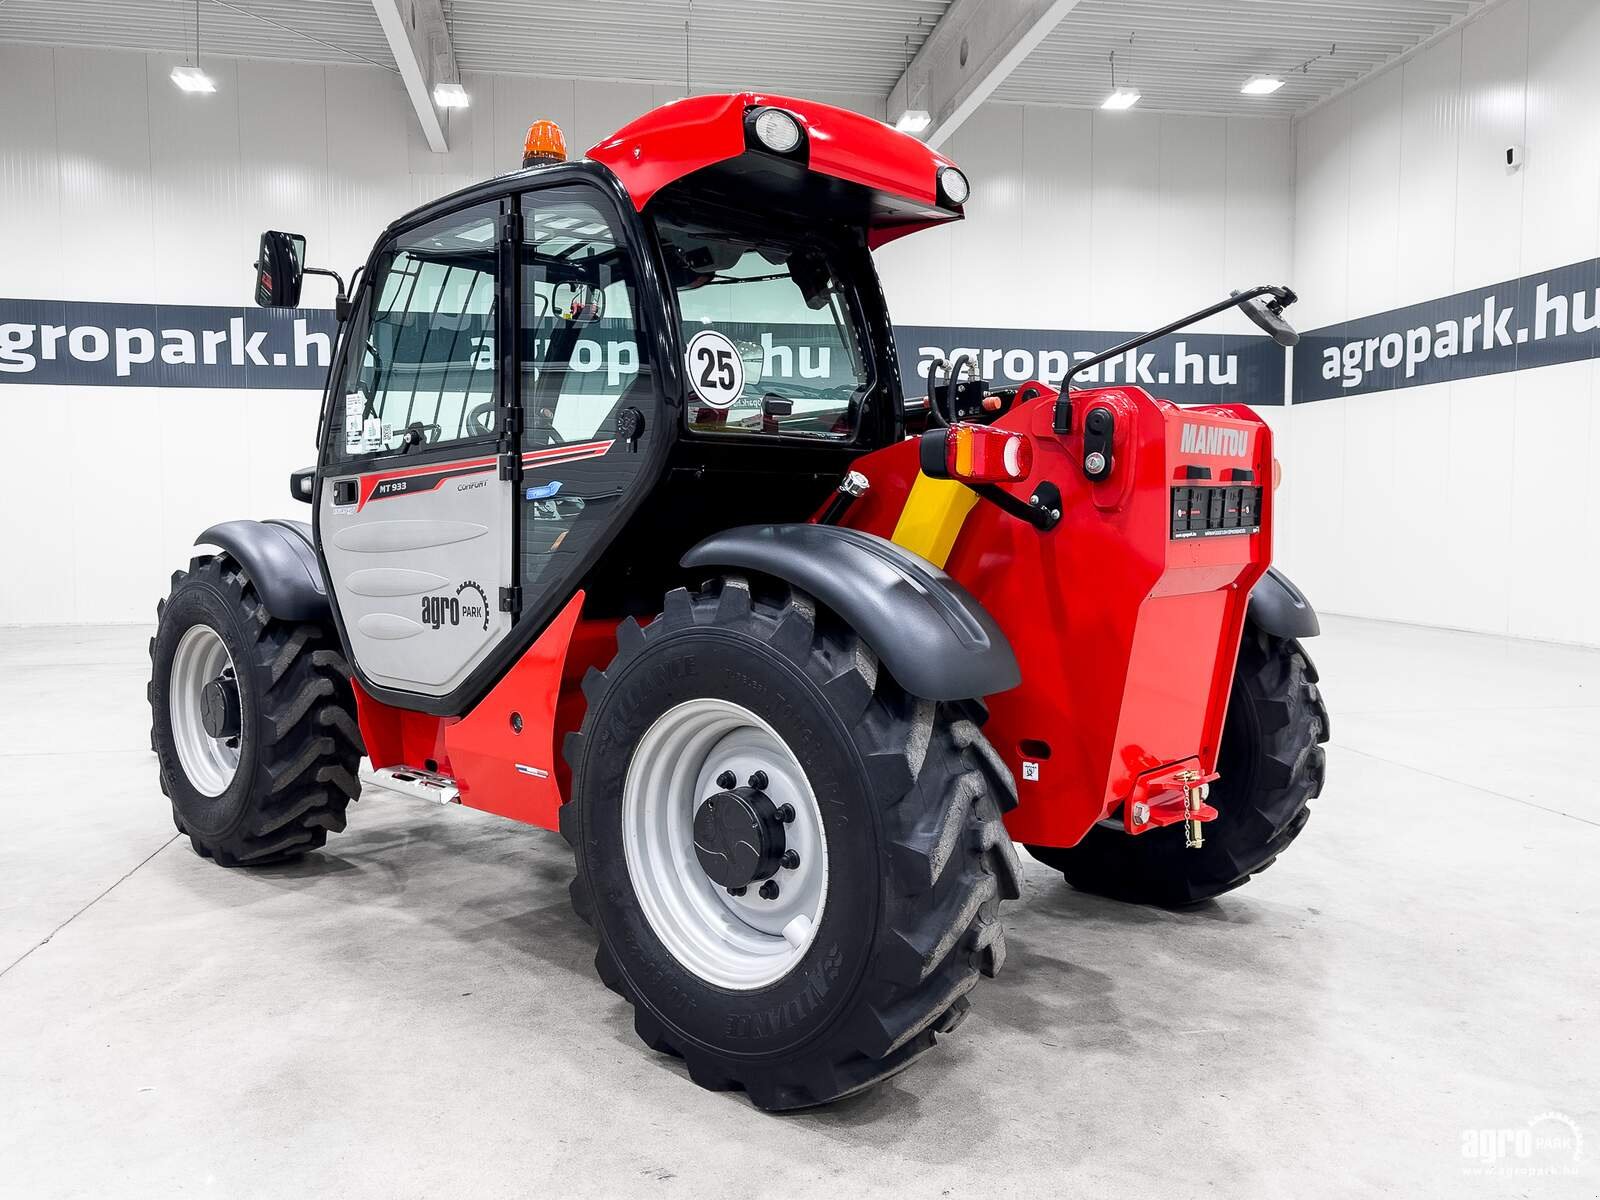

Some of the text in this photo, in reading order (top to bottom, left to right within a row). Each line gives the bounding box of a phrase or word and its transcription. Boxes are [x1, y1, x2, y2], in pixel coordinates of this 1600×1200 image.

[1322, 282, 1600, 388] agropark.hu
[697, 347, 736, 391] 25
[1180, 423, 1249, 457] MANITOU
[379, 482, 407, 494] MT 933
[421, 596, 482, 630] agro PARK
